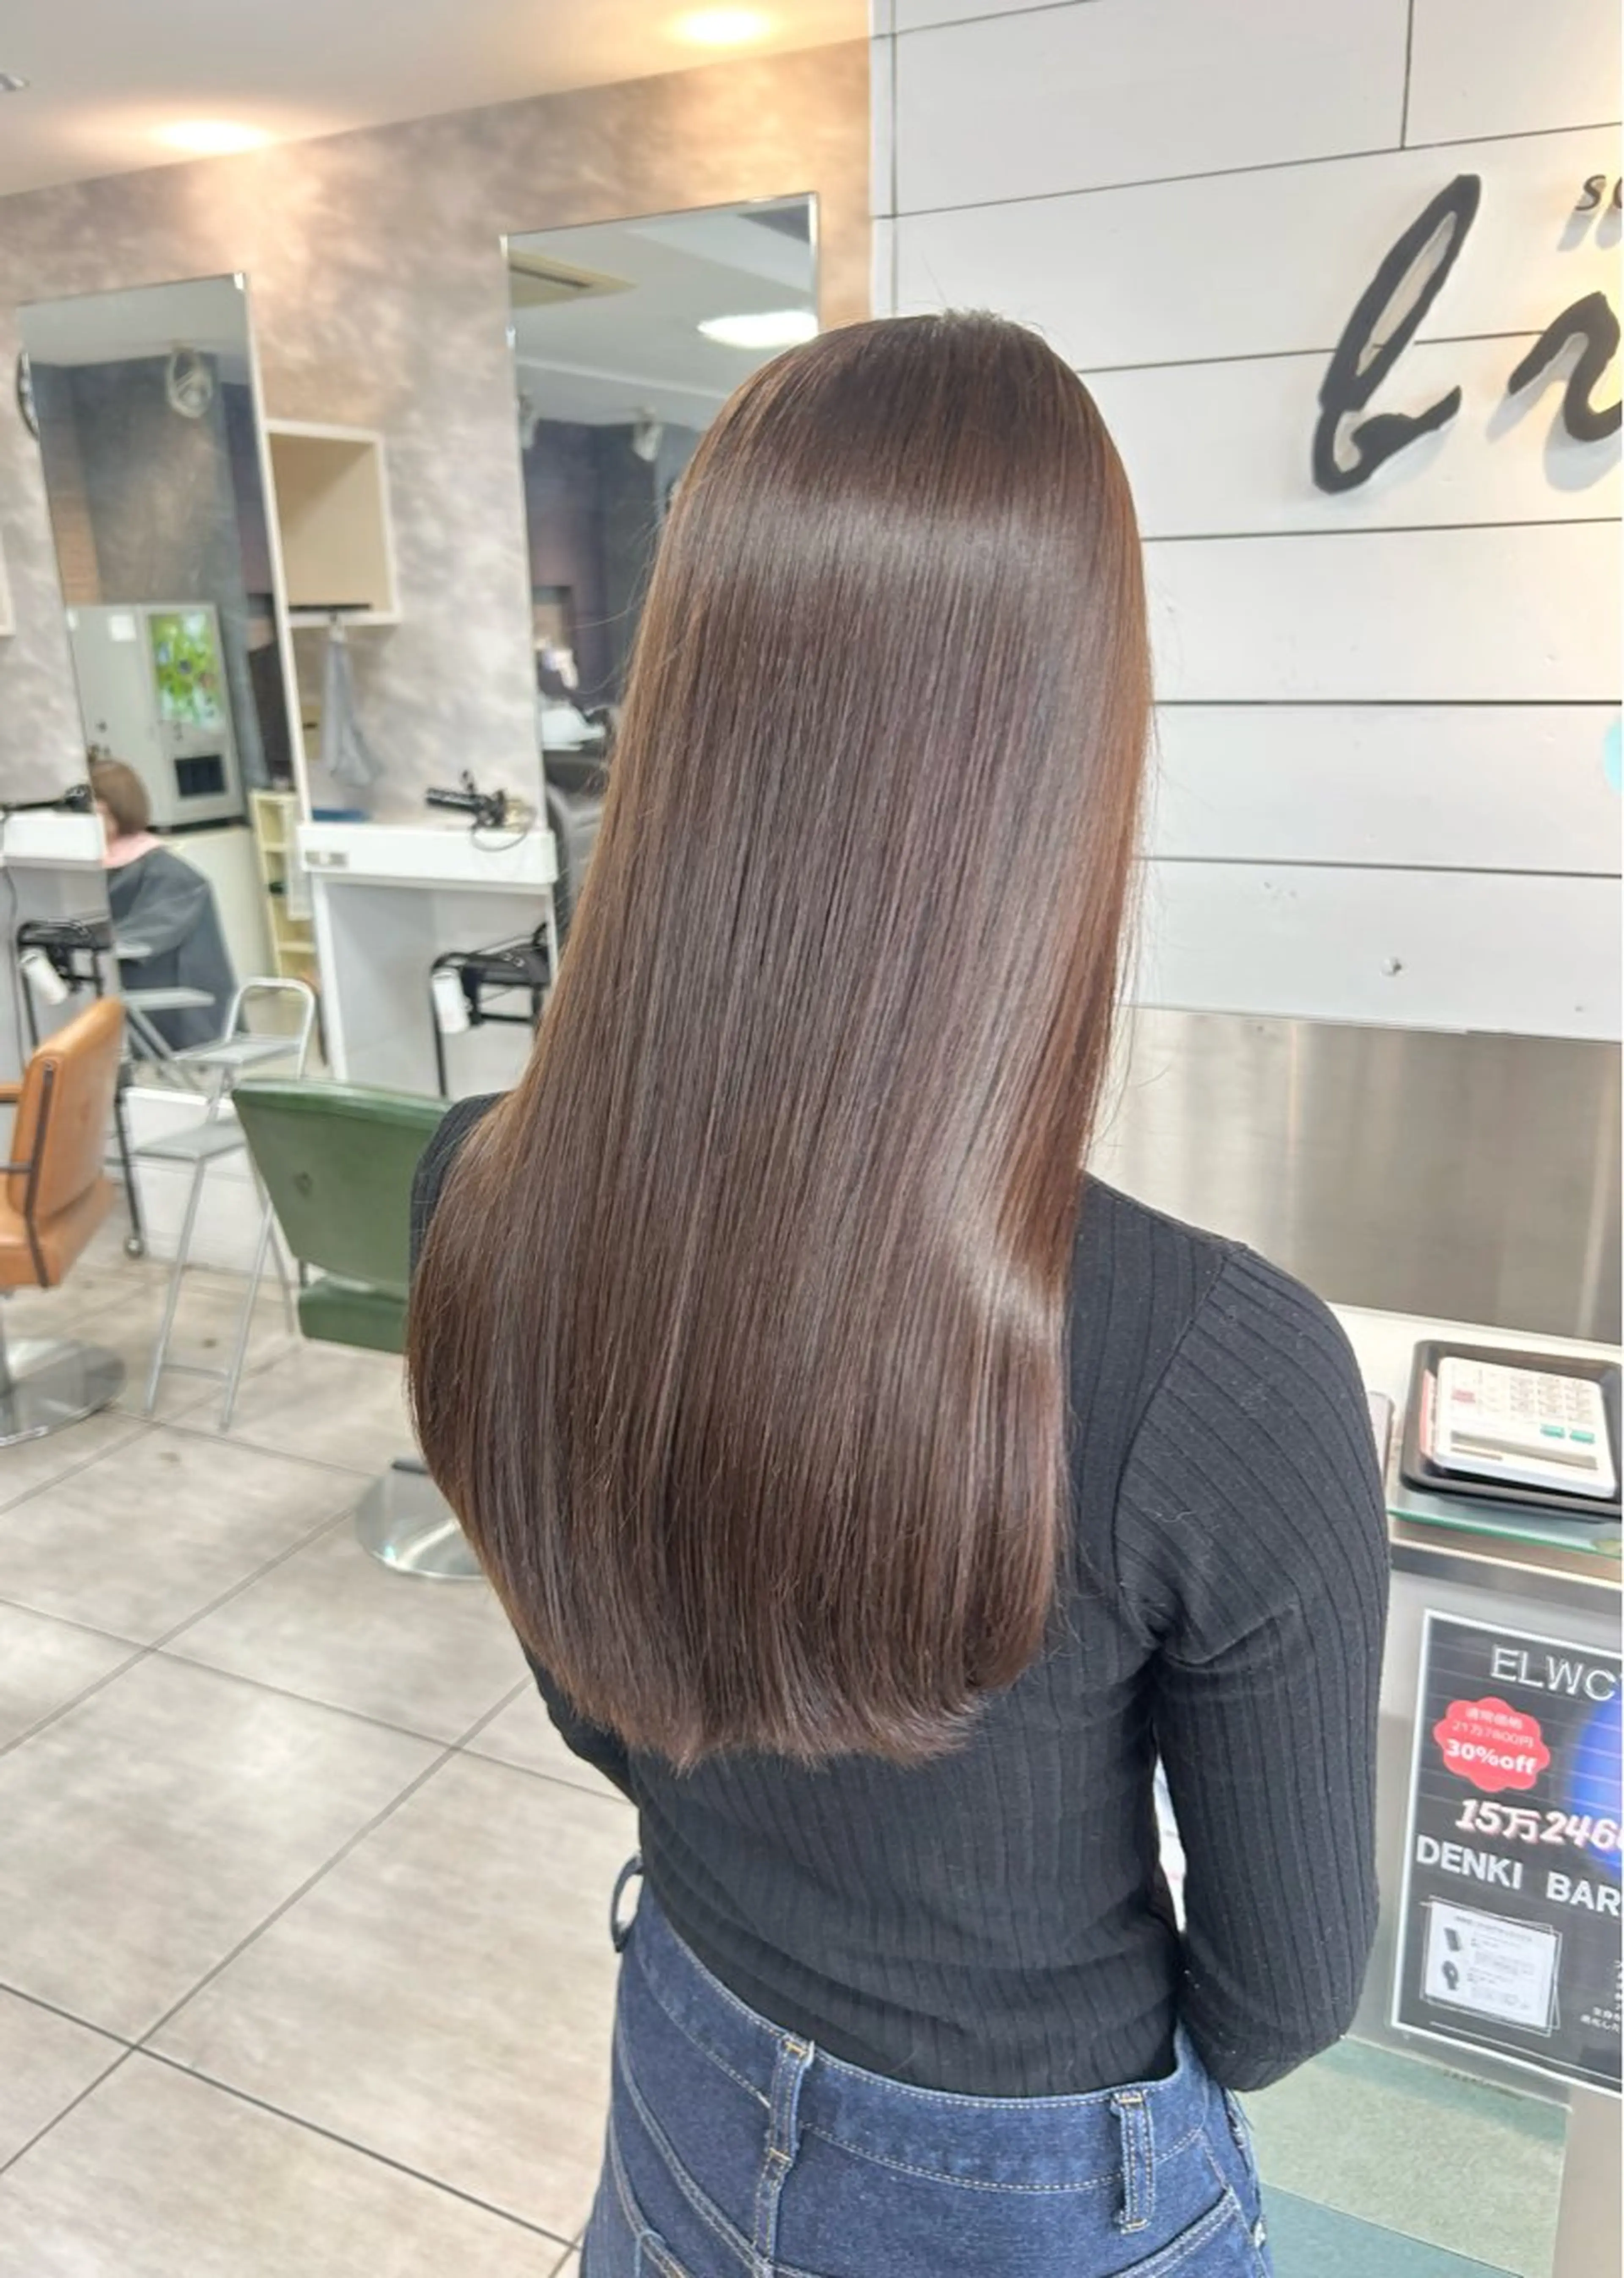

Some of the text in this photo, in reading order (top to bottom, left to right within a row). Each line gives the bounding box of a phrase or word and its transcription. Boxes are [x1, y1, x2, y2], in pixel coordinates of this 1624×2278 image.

[1490, 1644, 1622, 1701] ELWC
[1446, 1738, 1538, 1775] 30%off
[1455, 1799, 1622, 1852] 15万246
[1416, 1834, 1622, 1916] DENKI BAR
